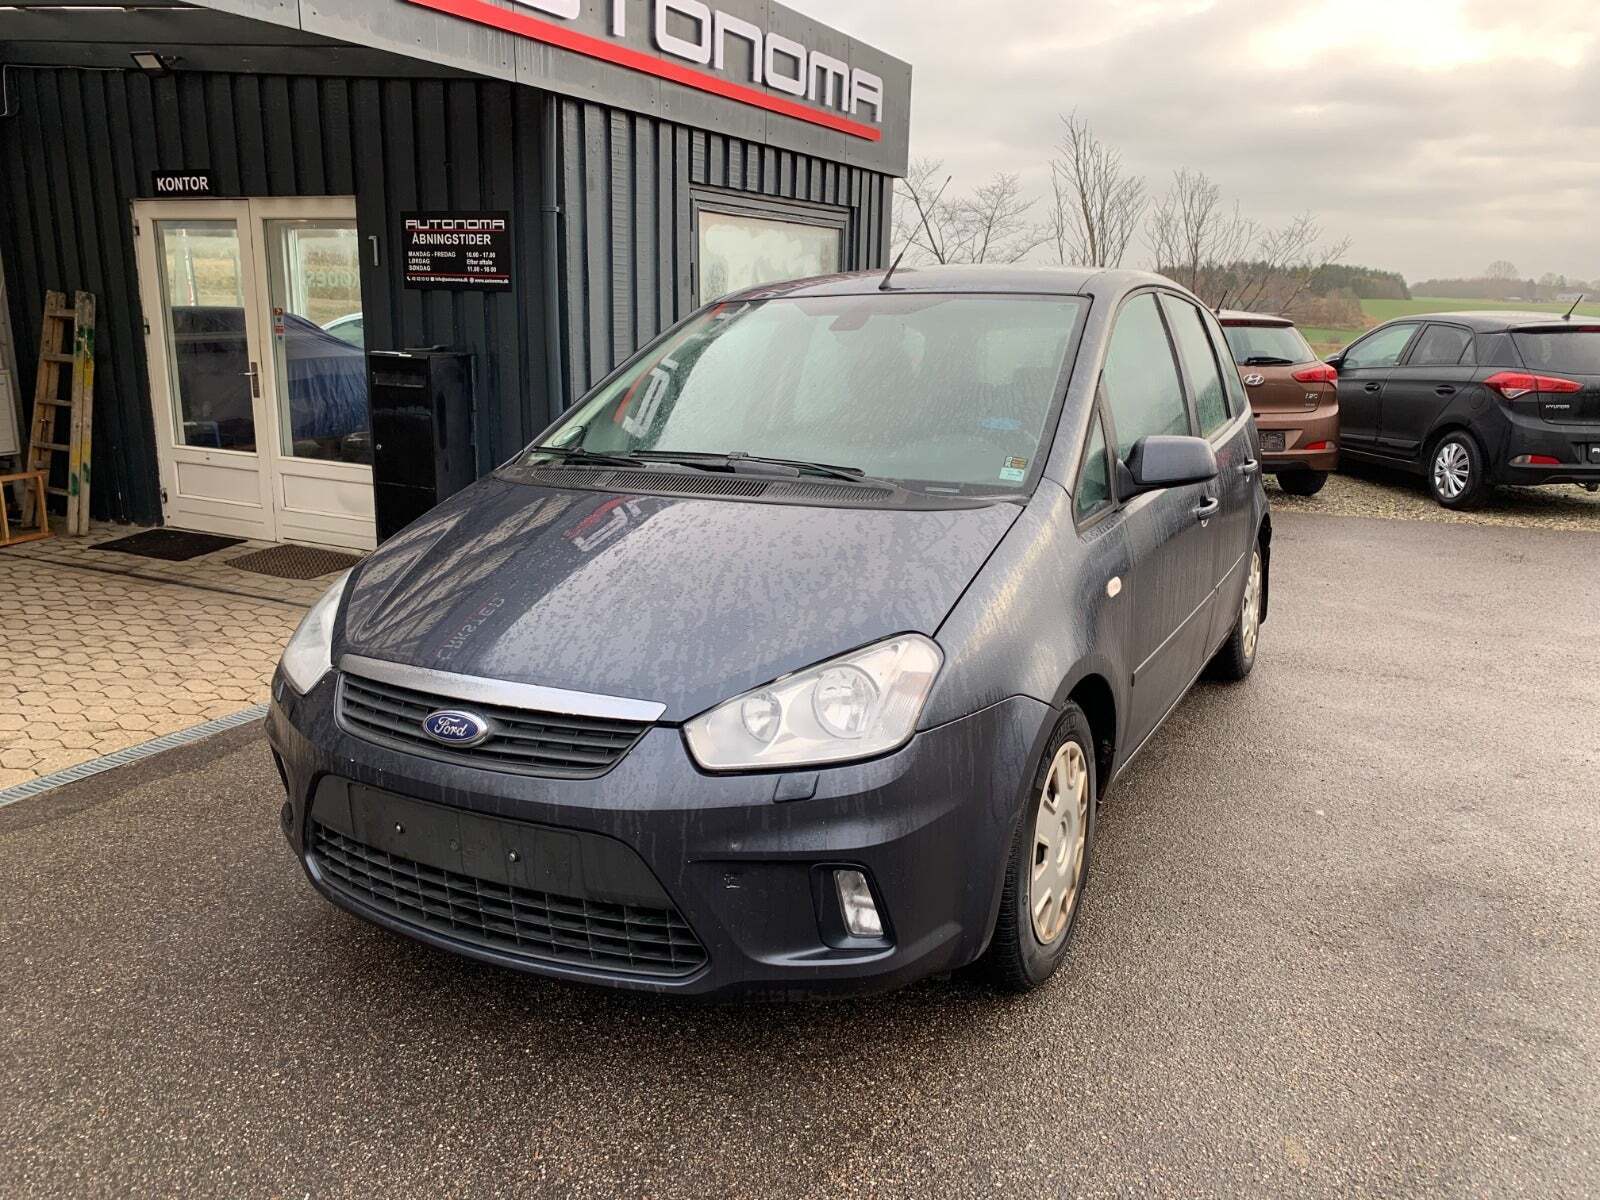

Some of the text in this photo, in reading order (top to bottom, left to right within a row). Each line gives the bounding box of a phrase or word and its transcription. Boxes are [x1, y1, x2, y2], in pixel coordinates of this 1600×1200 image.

[505, 0, 883, 122] ONOMA
[156, 176, 209, 191] KONTOR
[405, 219, 505, 230] AUTONOMA
[412, 232, 491, 245] ÅBNINGSTIDER
[434, 716, 468, 737] Ford
